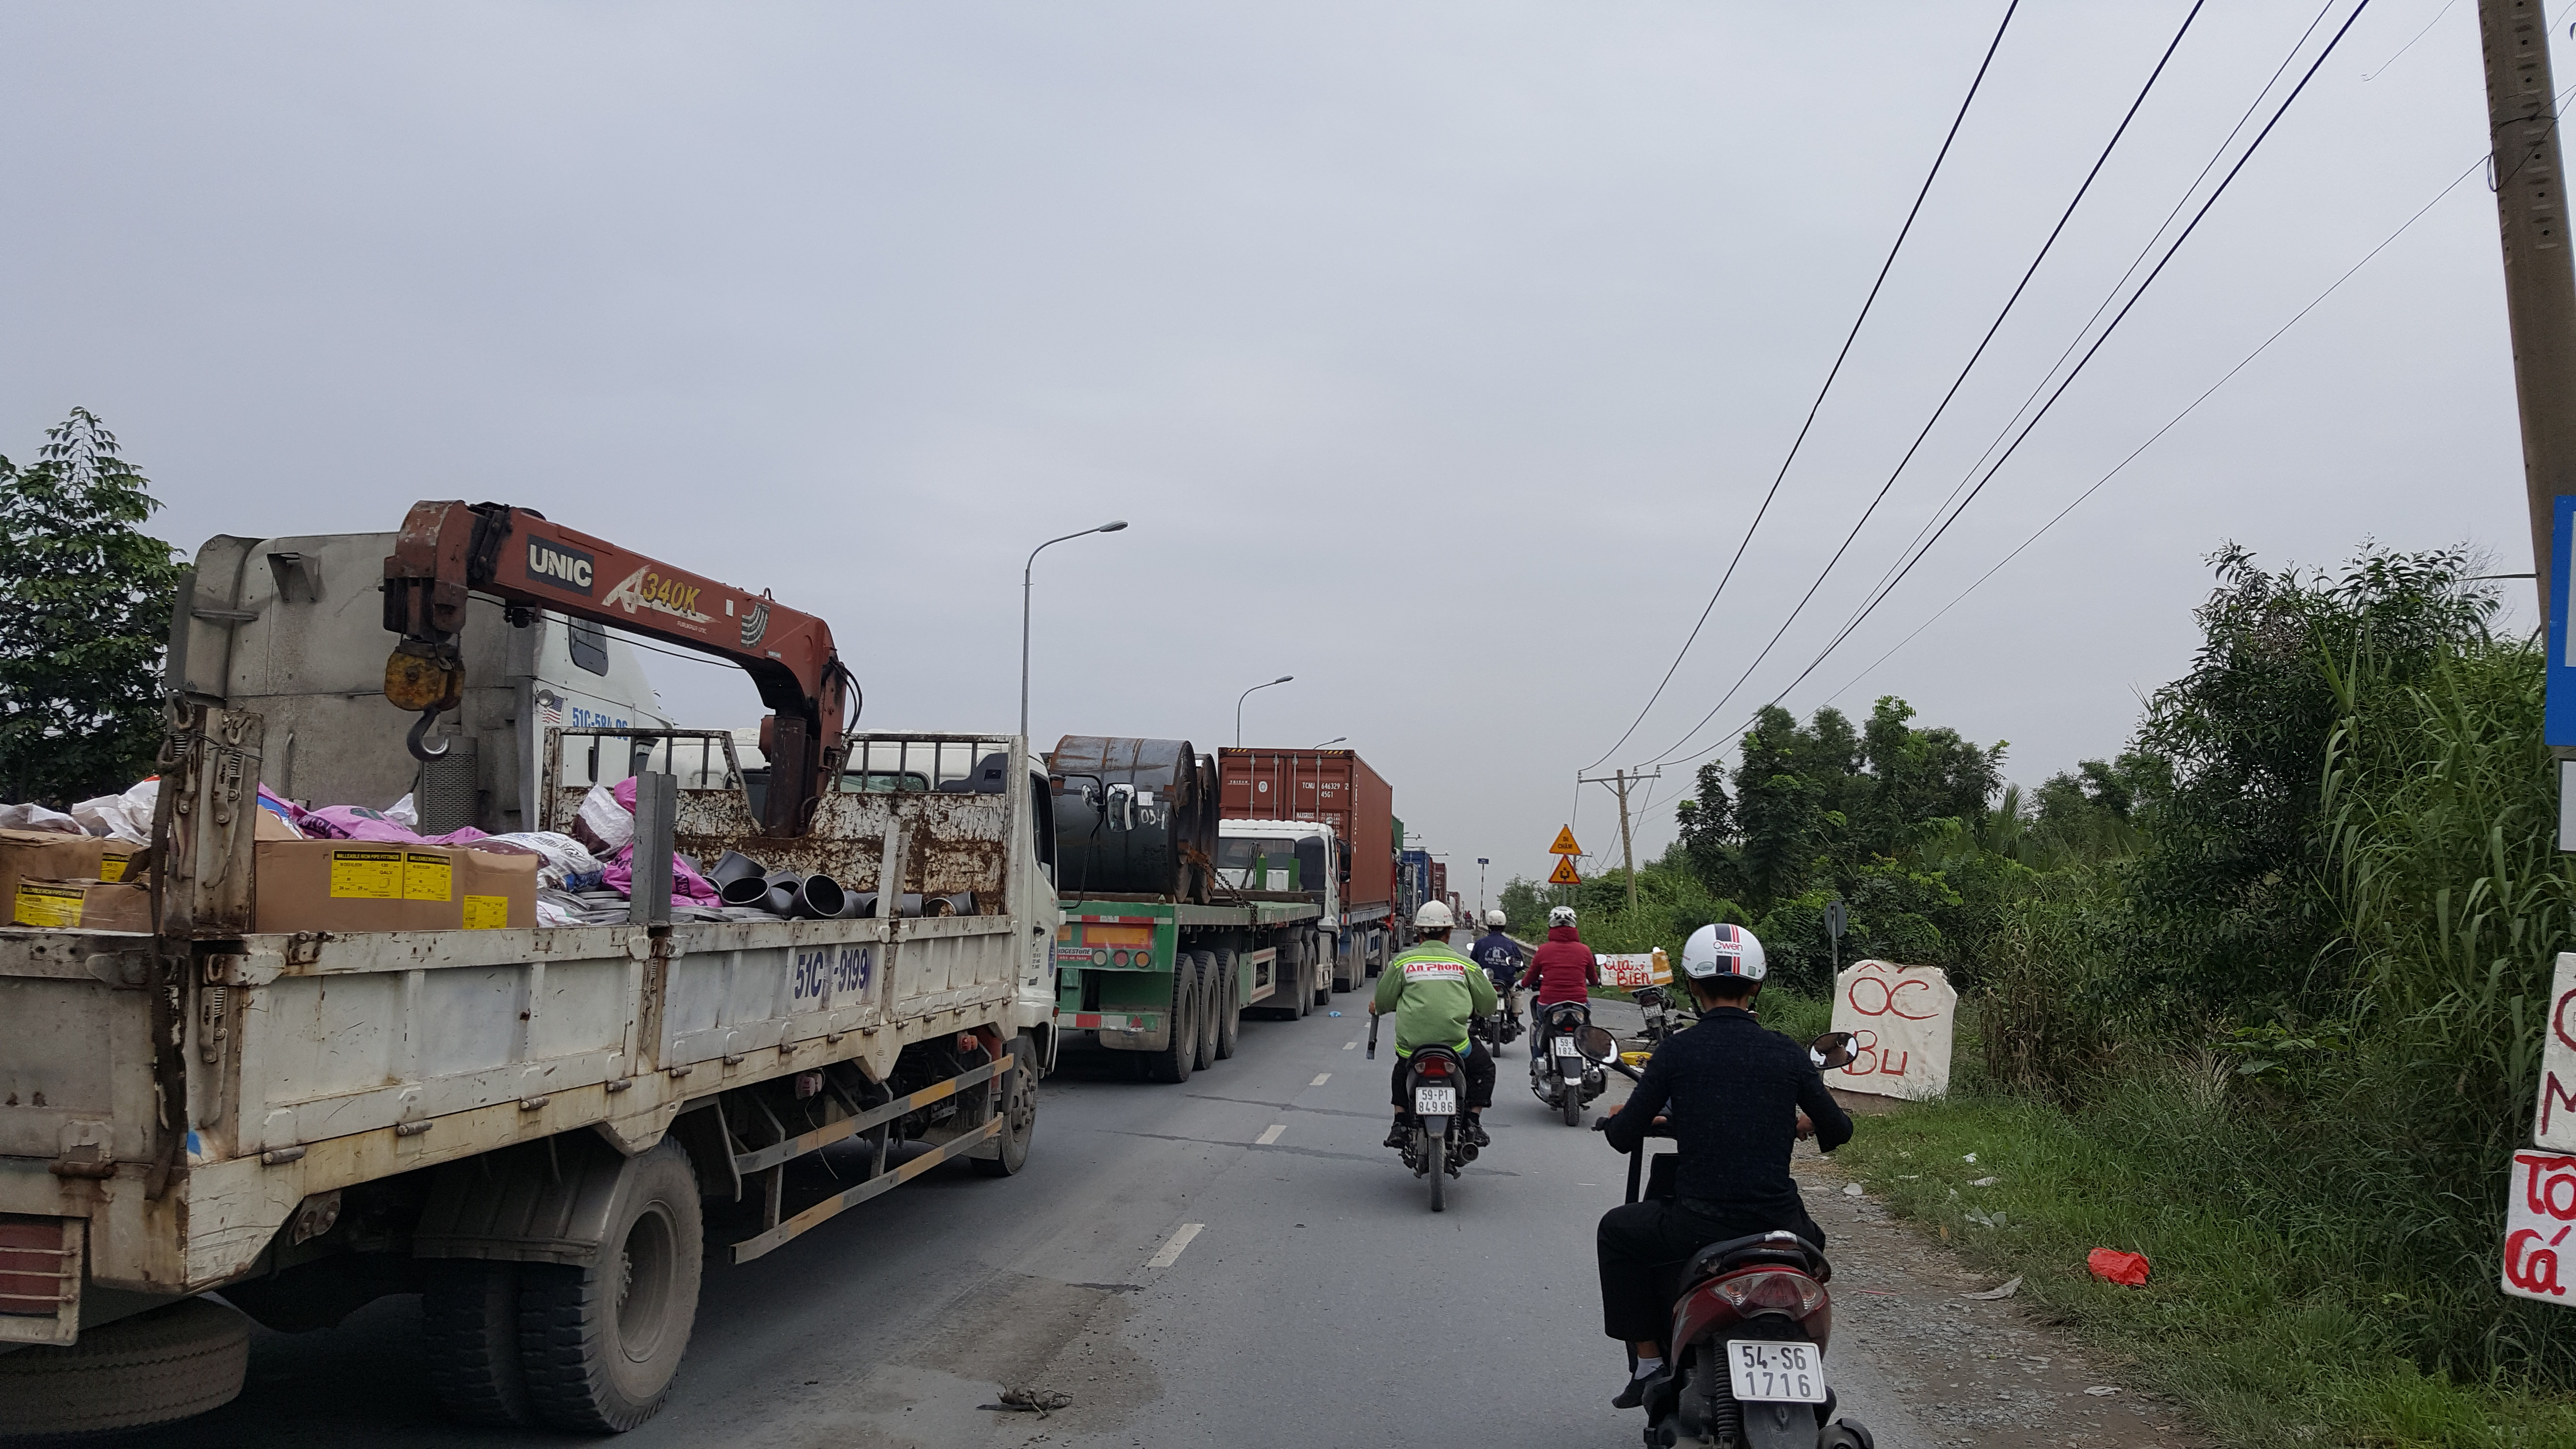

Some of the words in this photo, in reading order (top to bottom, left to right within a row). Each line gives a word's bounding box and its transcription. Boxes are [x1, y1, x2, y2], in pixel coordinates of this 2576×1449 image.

[530, 544, 592, 587] UNIC
[643, 573, 701, 616] 340K
[1713, 941, 1743, 951] Owen
[1406, 964, 1423, 973] An
[1425, 964, 1465, 975] Phong
[1419, 1101, 1453, 1112] 849.86
[1422, 1090, 1448, 1100] 59-P1
[2505, 1225, 2571, 1295] Cá
[1742, 1346, 1806, 1370] 54-S6
[1746, 1371, 1811, 1398] 1716
